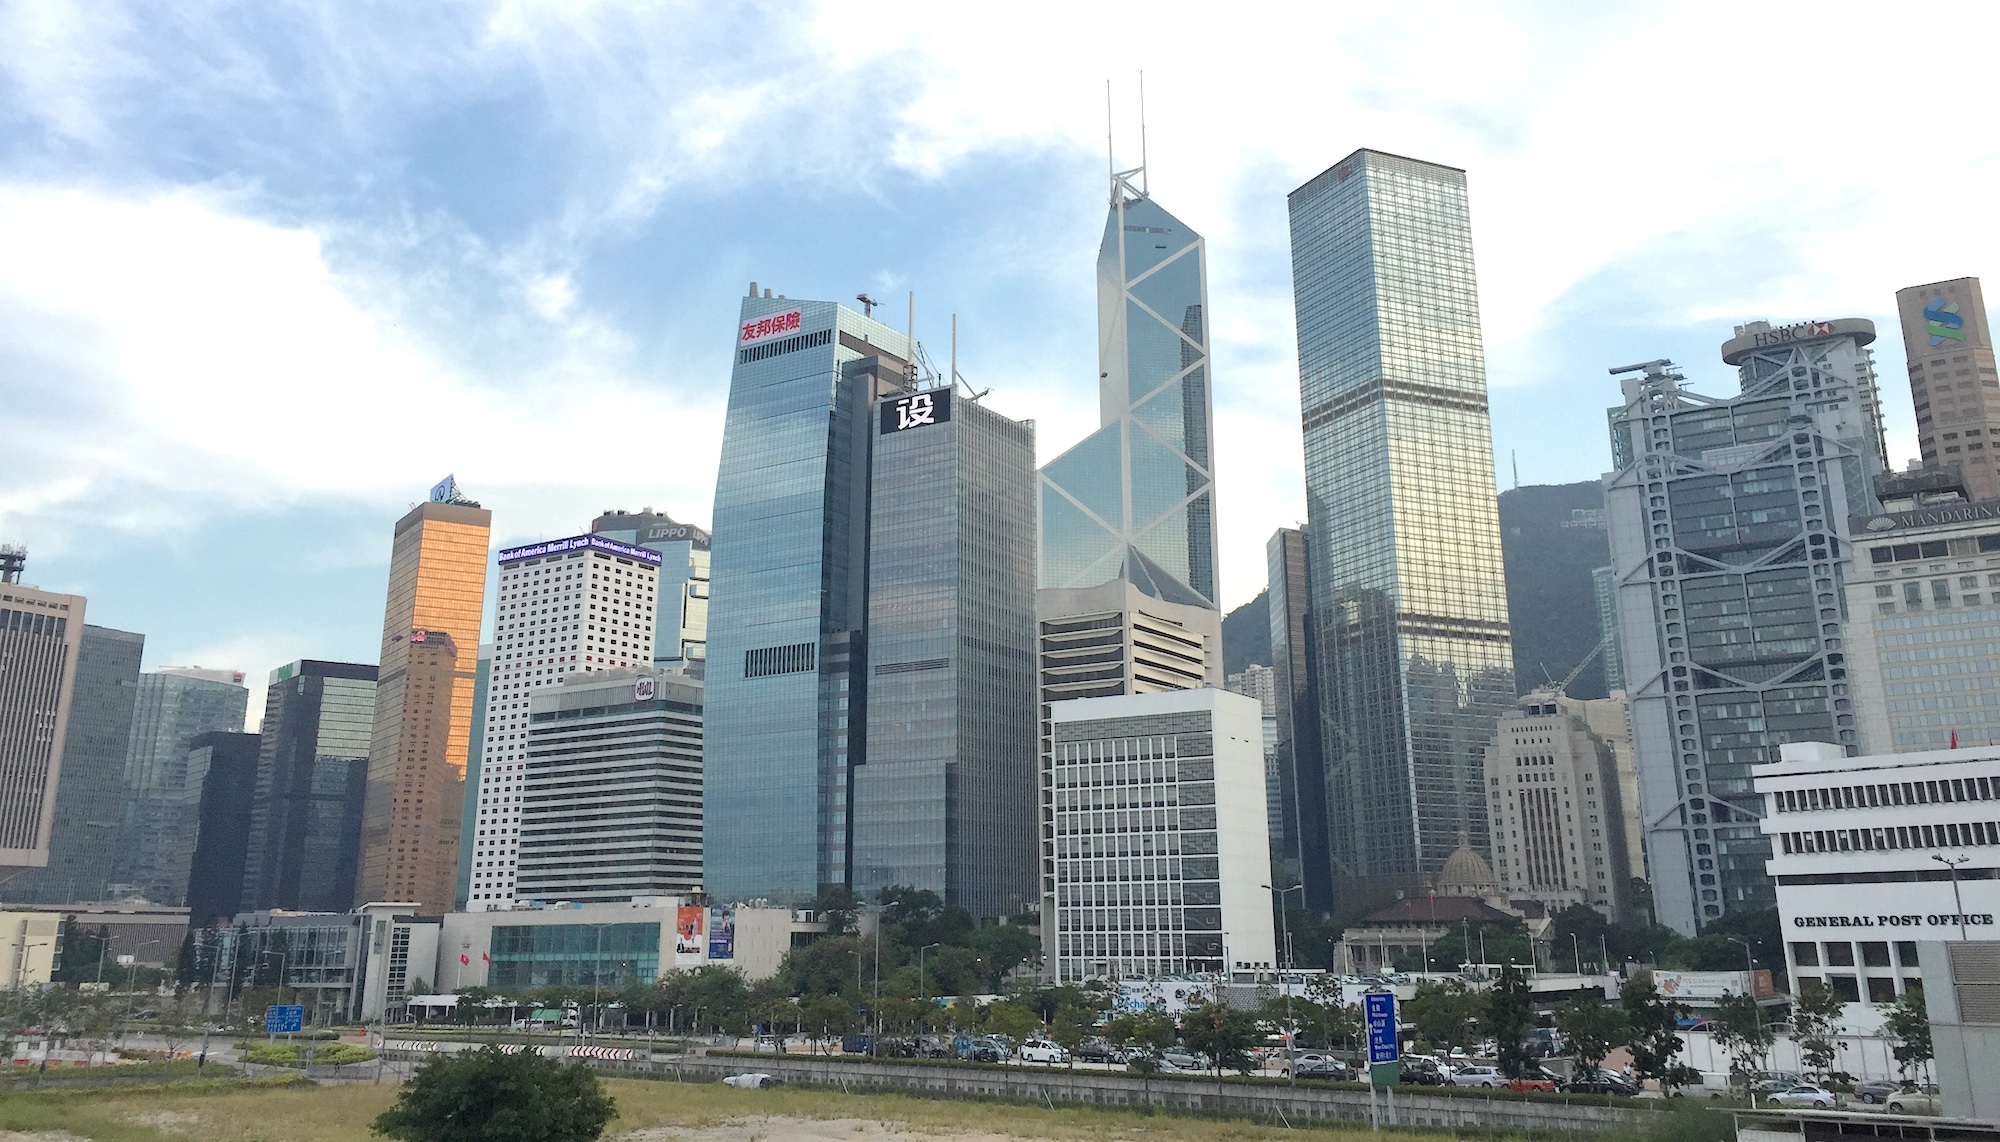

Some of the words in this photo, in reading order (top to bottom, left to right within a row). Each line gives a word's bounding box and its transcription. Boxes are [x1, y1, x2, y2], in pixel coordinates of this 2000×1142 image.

[741, 311, 801, 341] 友邦保險
[1753, 326, 1805, 346] HSBC
[896, 393, 935, 430] 设
[1901, 505, 1993, 528] MANDARIN
[648, 527, 687, 539] LIPPO
[498, 550, 514, 562] Bank
[514, 549, 522, 559] of
[521, 546, 547, 558] America
[547, 540, 569, 553] Merrill
[569, 536, 589, 549] Lynch
[647, 550, 662, 562] Lynch
[1794, 915, 1874, 927] GENERAL
[1877, 915, 1922, 927] POST
[1927, 914, 1994, 926] OFFICE
